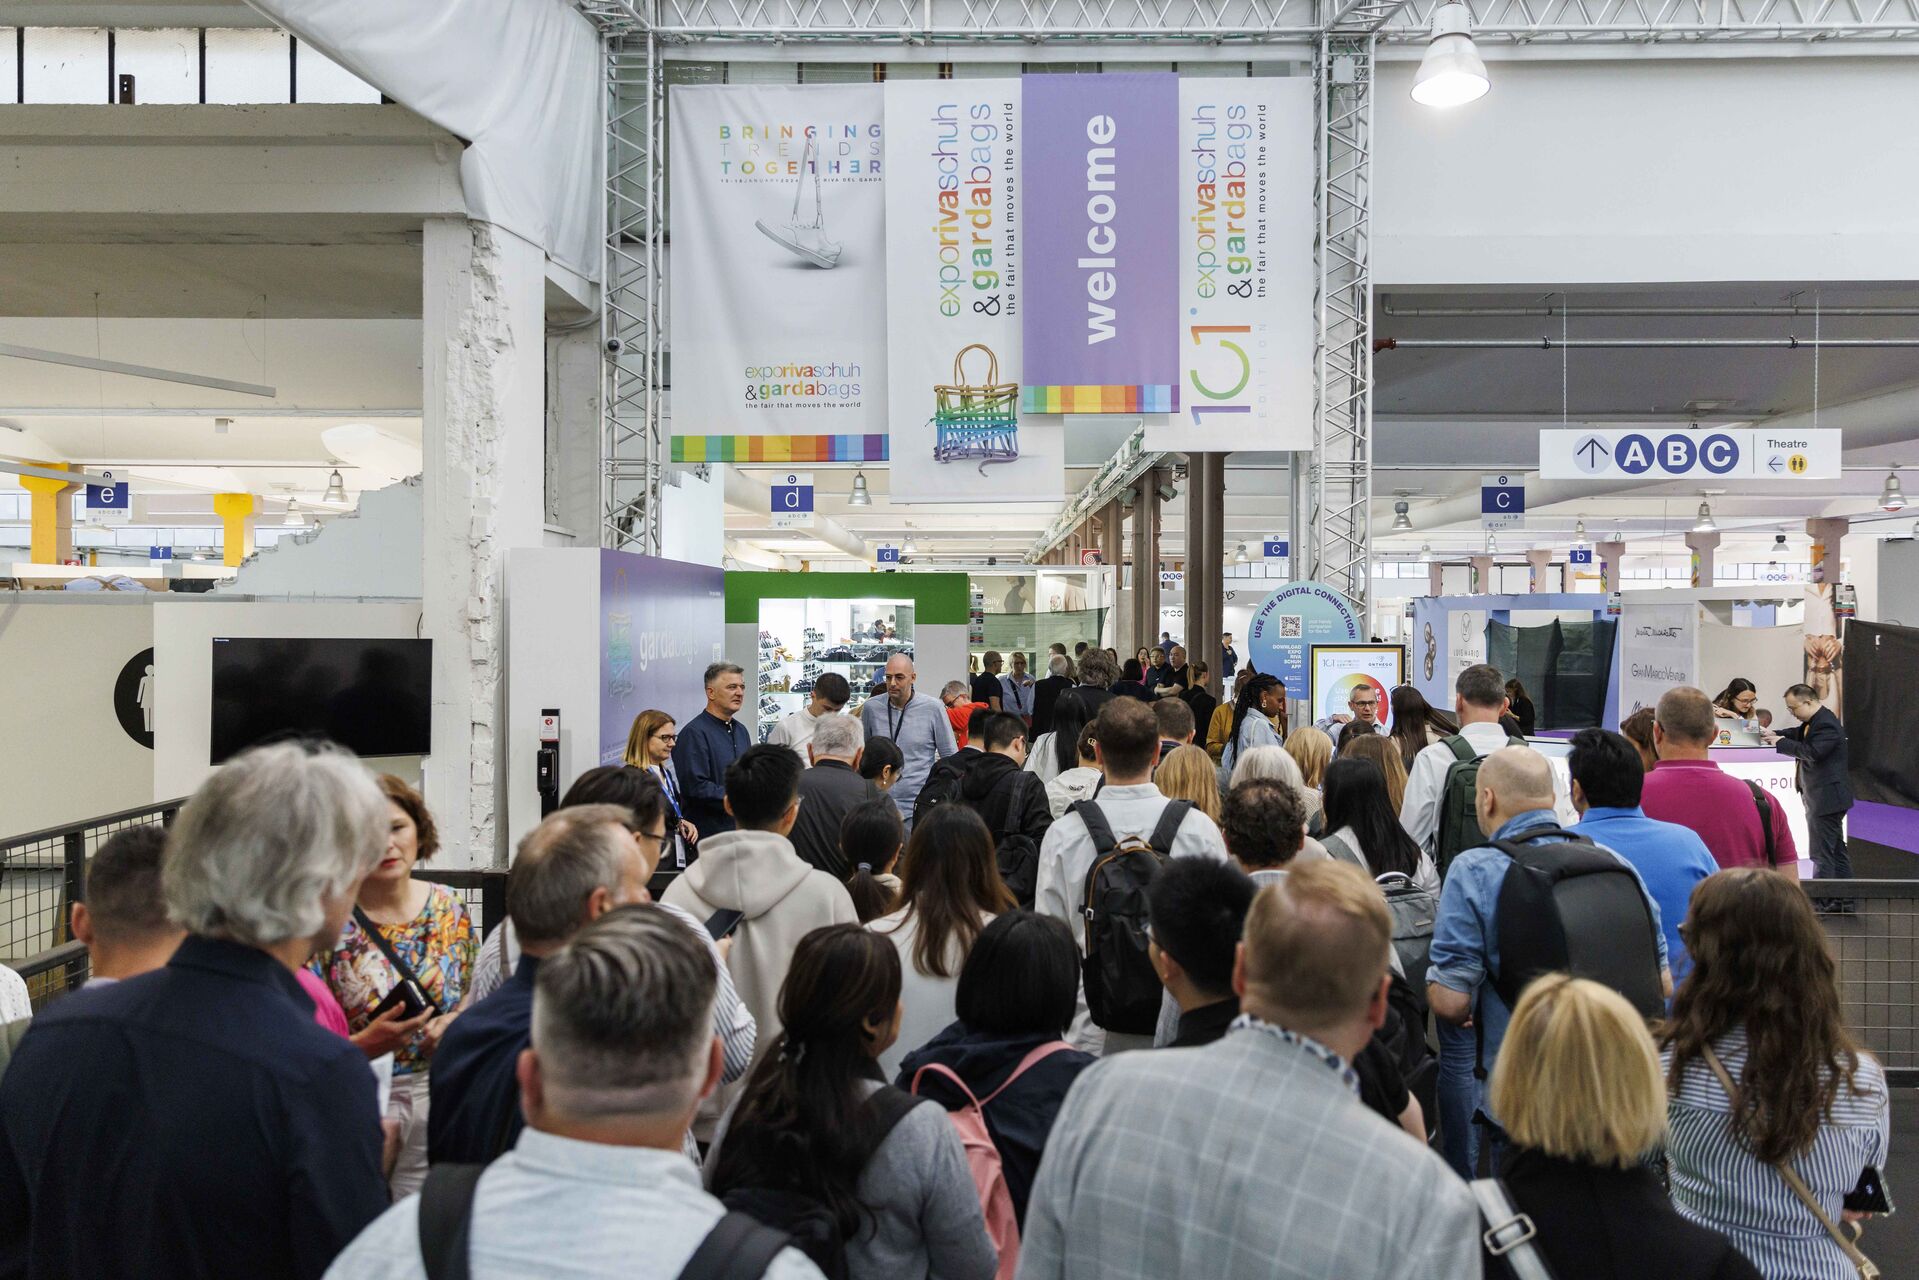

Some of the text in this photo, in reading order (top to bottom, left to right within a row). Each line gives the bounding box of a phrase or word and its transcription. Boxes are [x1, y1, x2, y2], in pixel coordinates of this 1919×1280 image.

[719, 124, 881, 139] BRINGING
[719, 141, 880, 157] TRENDS
[931, 104, 967, 317] exporivaschuh
[964, 104, 1000, 317] & gardabags
[1003, 103, 1016, 316] the fair that moves the world
[1191, 104, 1222, 299] exporivaschuh
[1221, 104, 1252, 298] & gardabags
[1257, 104, 1266, 298] the fair that moves the world
[1077, 114, 1117, 346] welcome
[744, 362, 861, 381] exporivaschuh
[745, 380, 861, 400] & gardabags
[1622, 440, 1732, 468] A B C
[1766, 439, 1808, 449] Theatre
[100, 488, 114, 503] e
[785, 487, 798, 508] d
[884, 550, 892, 560] d
[1577, 550, 1584, 562] b
[1254, 586, 1356, 640] USE THE DIGITAL CONNECTION!
[1770, 777, 1792, 789] POI
